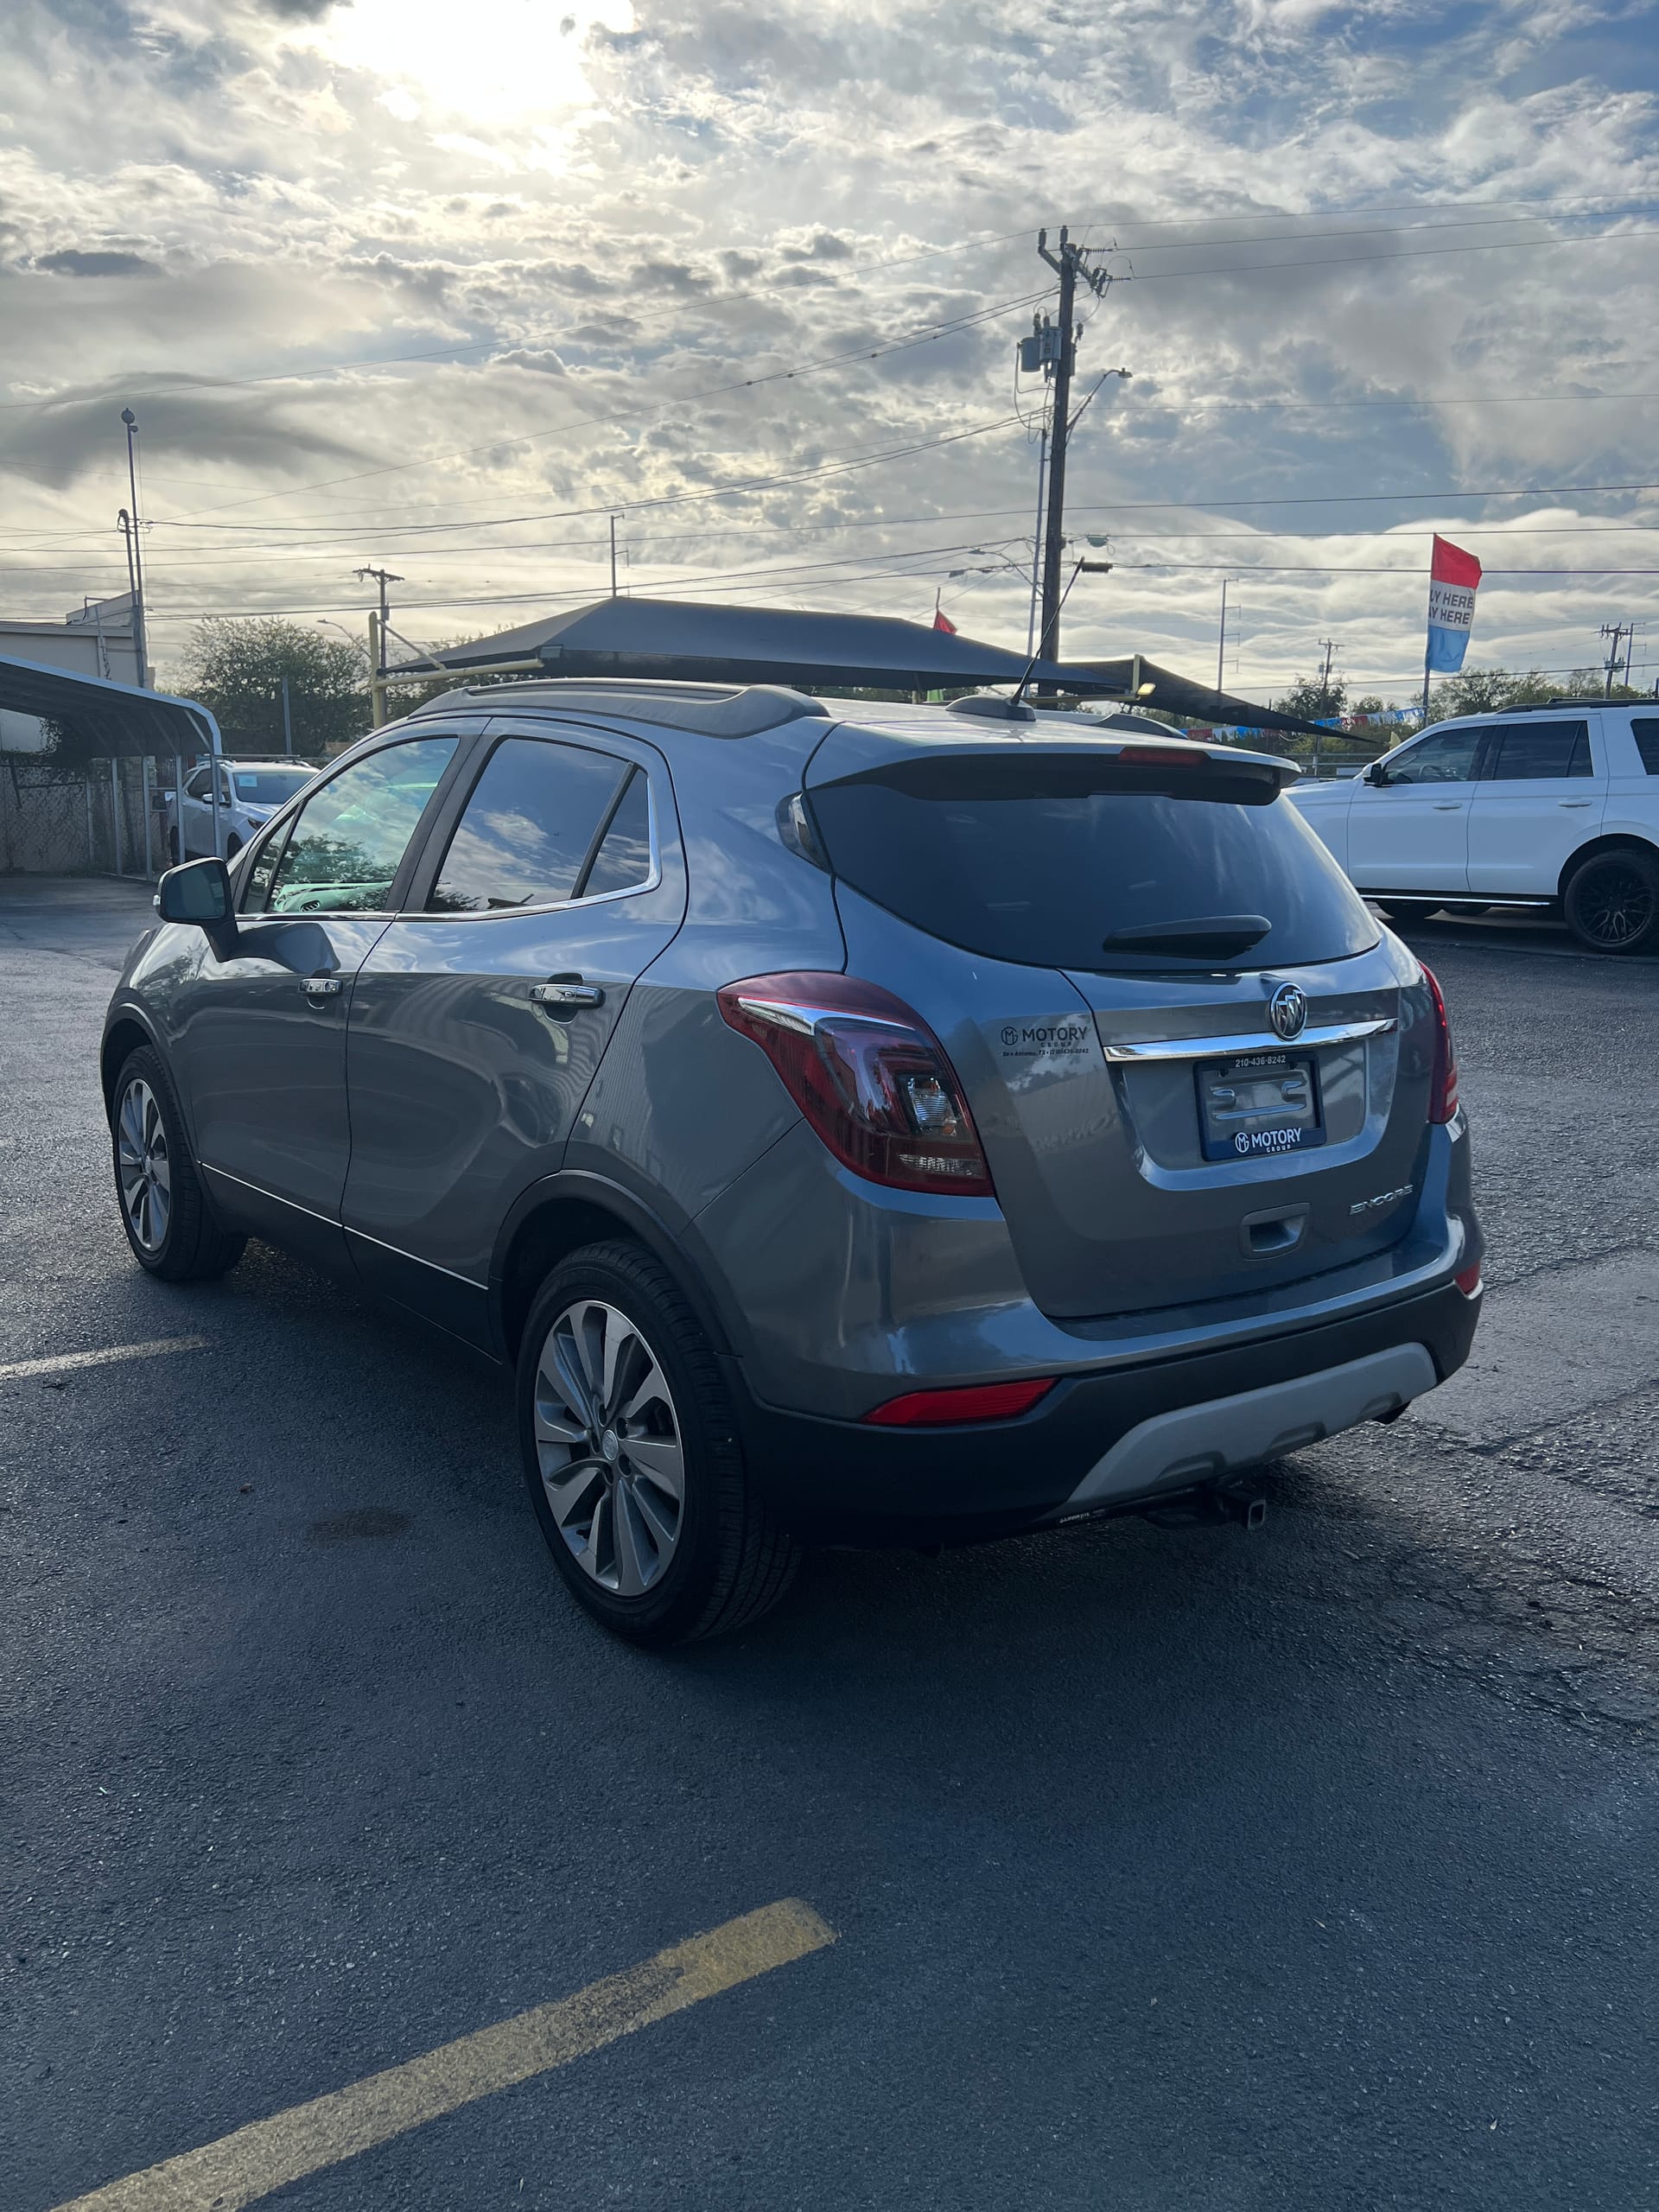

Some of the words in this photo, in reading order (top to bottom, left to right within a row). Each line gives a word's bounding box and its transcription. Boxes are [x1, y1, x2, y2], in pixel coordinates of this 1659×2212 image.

[1443, 593, 1473, 609] HERE
[1440, 608, 1470, 625] HERE
[1022, 1027, 1088, 1042] MOTORY
[1251, 1128, 1301, 1148] MOTORY
[1266, 1144, 1291, 1154] GROUP
[1349, 1185, 1414, 1215] ENCORE
